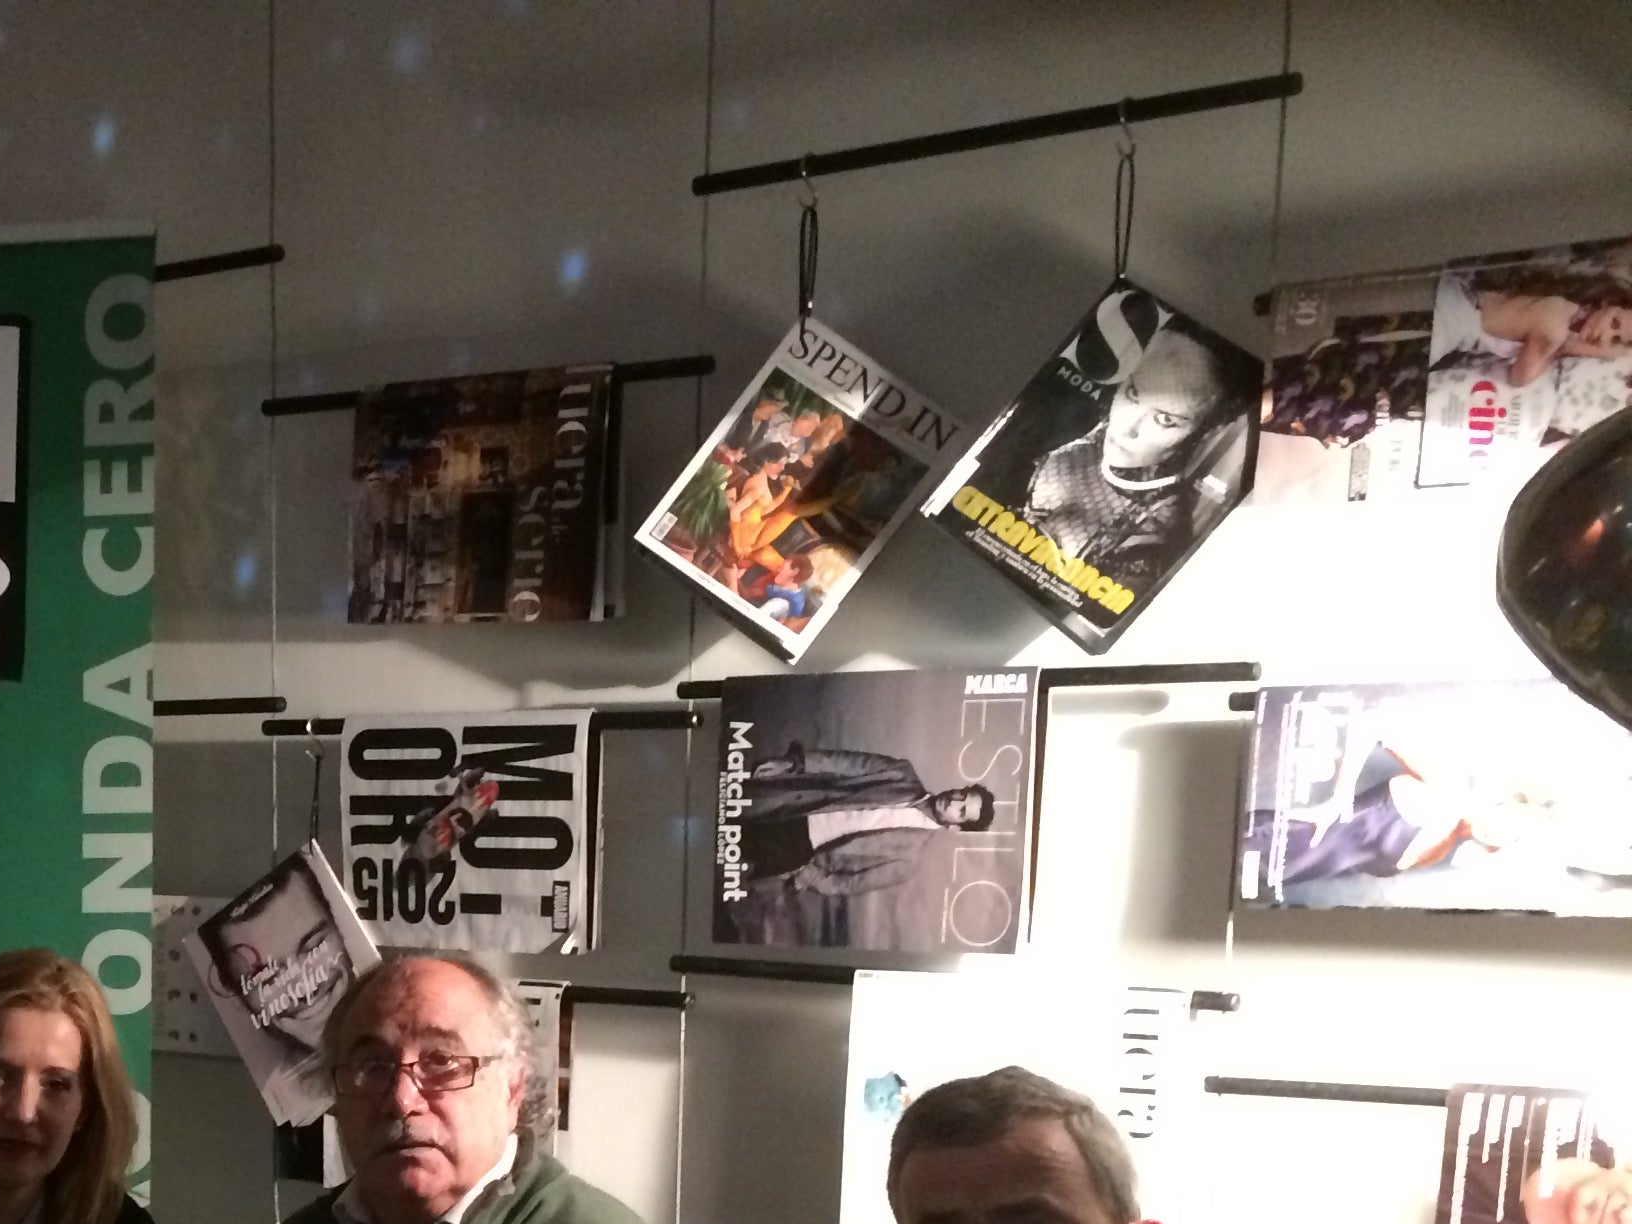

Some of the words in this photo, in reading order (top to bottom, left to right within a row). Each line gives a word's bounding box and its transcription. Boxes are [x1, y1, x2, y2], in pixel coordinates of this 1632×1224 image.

[788, 328, 906, 419] SPEND
[904, 405, 960, 452] IN
[1056, 364, 1103, 402] MODA
[82, 273, 156, 597] CERO
[964, 673, 1028, 695] MARCA
[726, 721, 755, 819] Match
[352, 856, 457, 926] 2015
[722, 824, 750, 903] point
